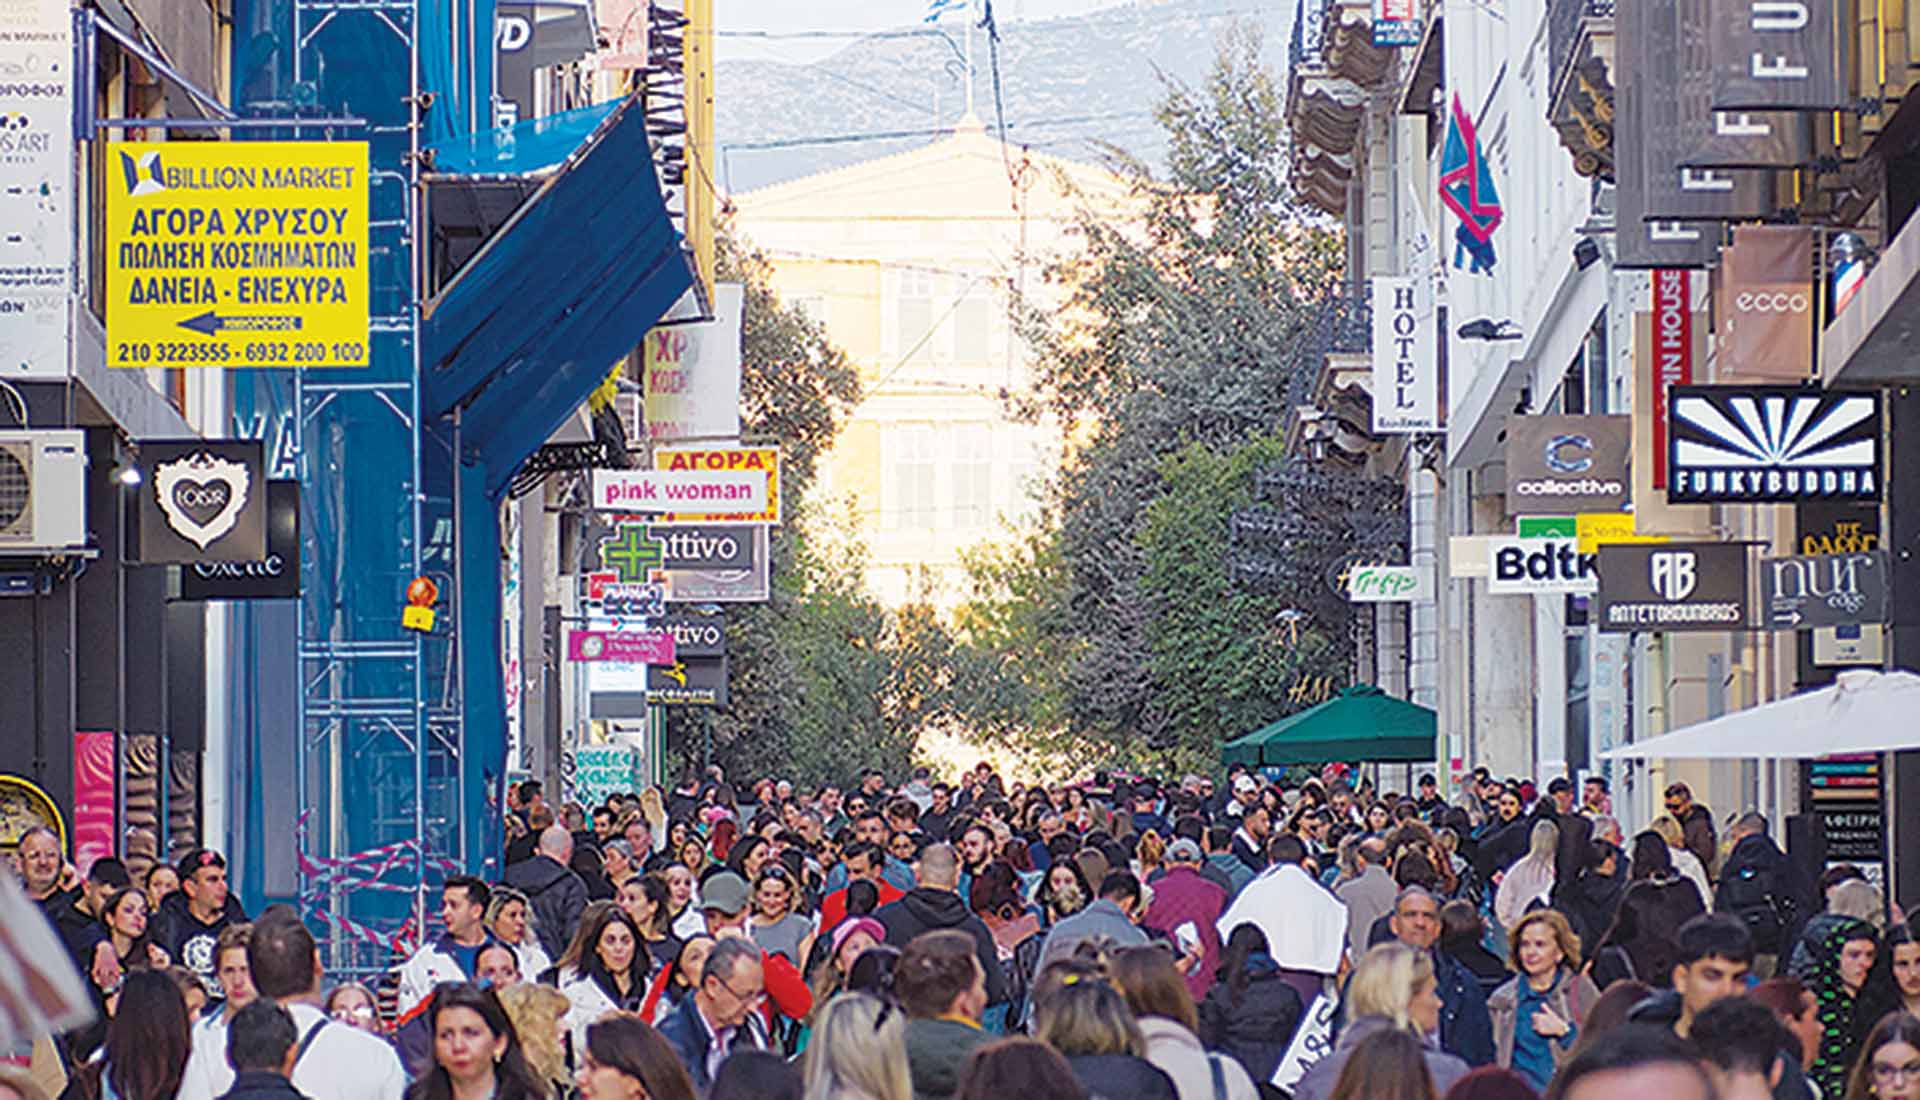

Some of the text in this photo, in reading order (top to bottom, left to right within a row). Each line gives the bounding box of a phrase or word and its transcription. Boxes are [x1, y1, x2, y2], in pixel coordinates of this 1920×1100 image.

[167, 167, 354, 190] BILLION MARKET
[131, 208, 348, 236] ΑΓΟΡΑ ΧΡΥΣΟΥ
[119, 242, 356, 269] ΠΩΛΗΣΗ ΚΟΣΜΗΜΑΤΩΝ
[129, 277, 216, 304] ΔΑΝΕΙΑ
[238, 277, 348, 304] ΕΝΕΧΥΡΑ
[1736, 292, 1808, 312] ecco
[1661, 270, 1682, 348] HOUSE
[118, 343, 151, 362] 210
[156, 342, 231, 362] 3223555
[246, 341, 289, 362] 6932
[294, 341, 327, 362] 200
[332, 342, 364, 362] 100
[1393, 288, 1415, 409] HOTEL
[669, 453, 764, 470] ΑΓΟΡΑ
[606, 479, 752, 504] pink woman
[1517, 480, 1622, 495] collective
[1677, 471, 1876, 493] FUNKYBUDDHA
[1774, 556, 1873, 598] nur
